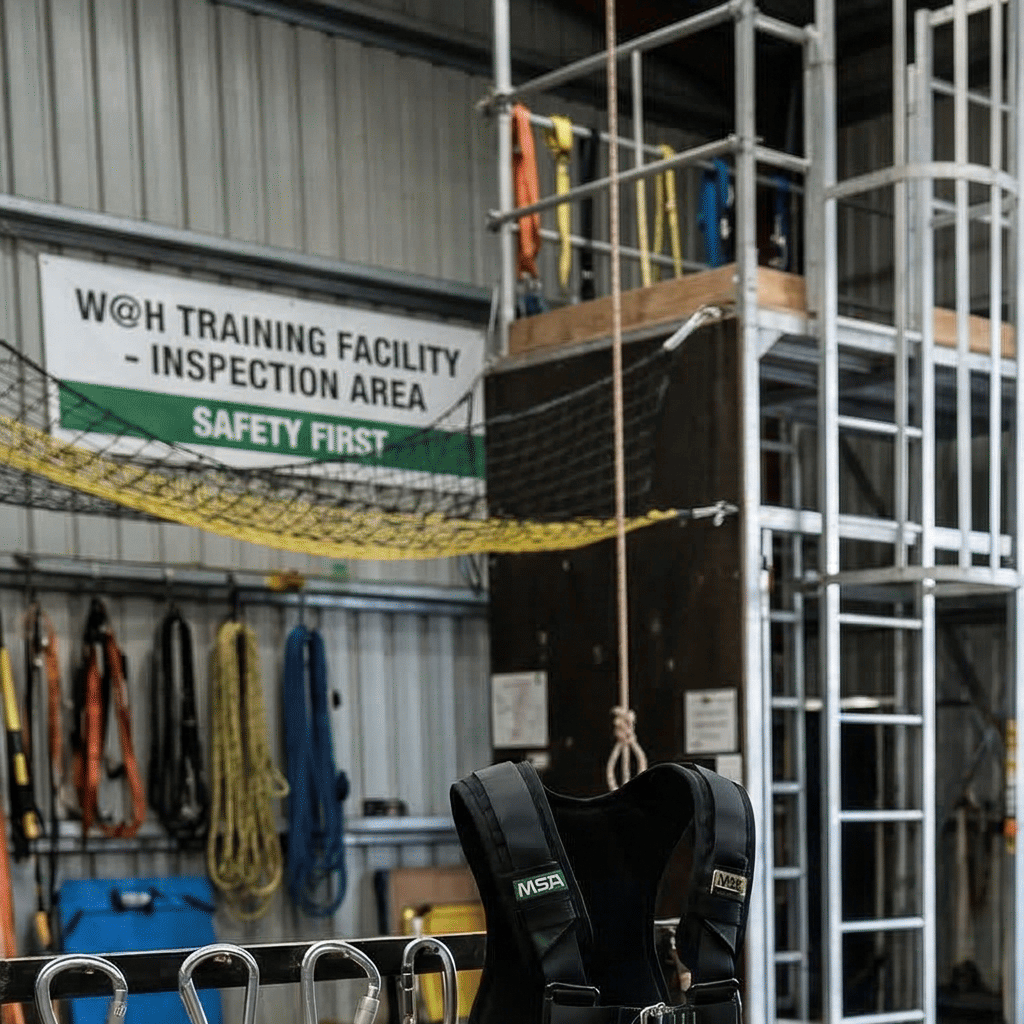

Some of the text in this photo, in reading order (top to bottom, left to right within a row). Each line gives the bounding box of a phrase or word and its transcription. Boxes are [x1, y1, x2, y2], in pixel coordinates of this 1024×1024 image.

[76, 288, 461, 379] W@H TRAINING FACILITY
[151, 344, 340, 401] INSPECTION
[350, 374, 427, 412] AREA
[192, 405, 389, 458] SAFETY FIRST
[517, 873, 565, 898] MSA
